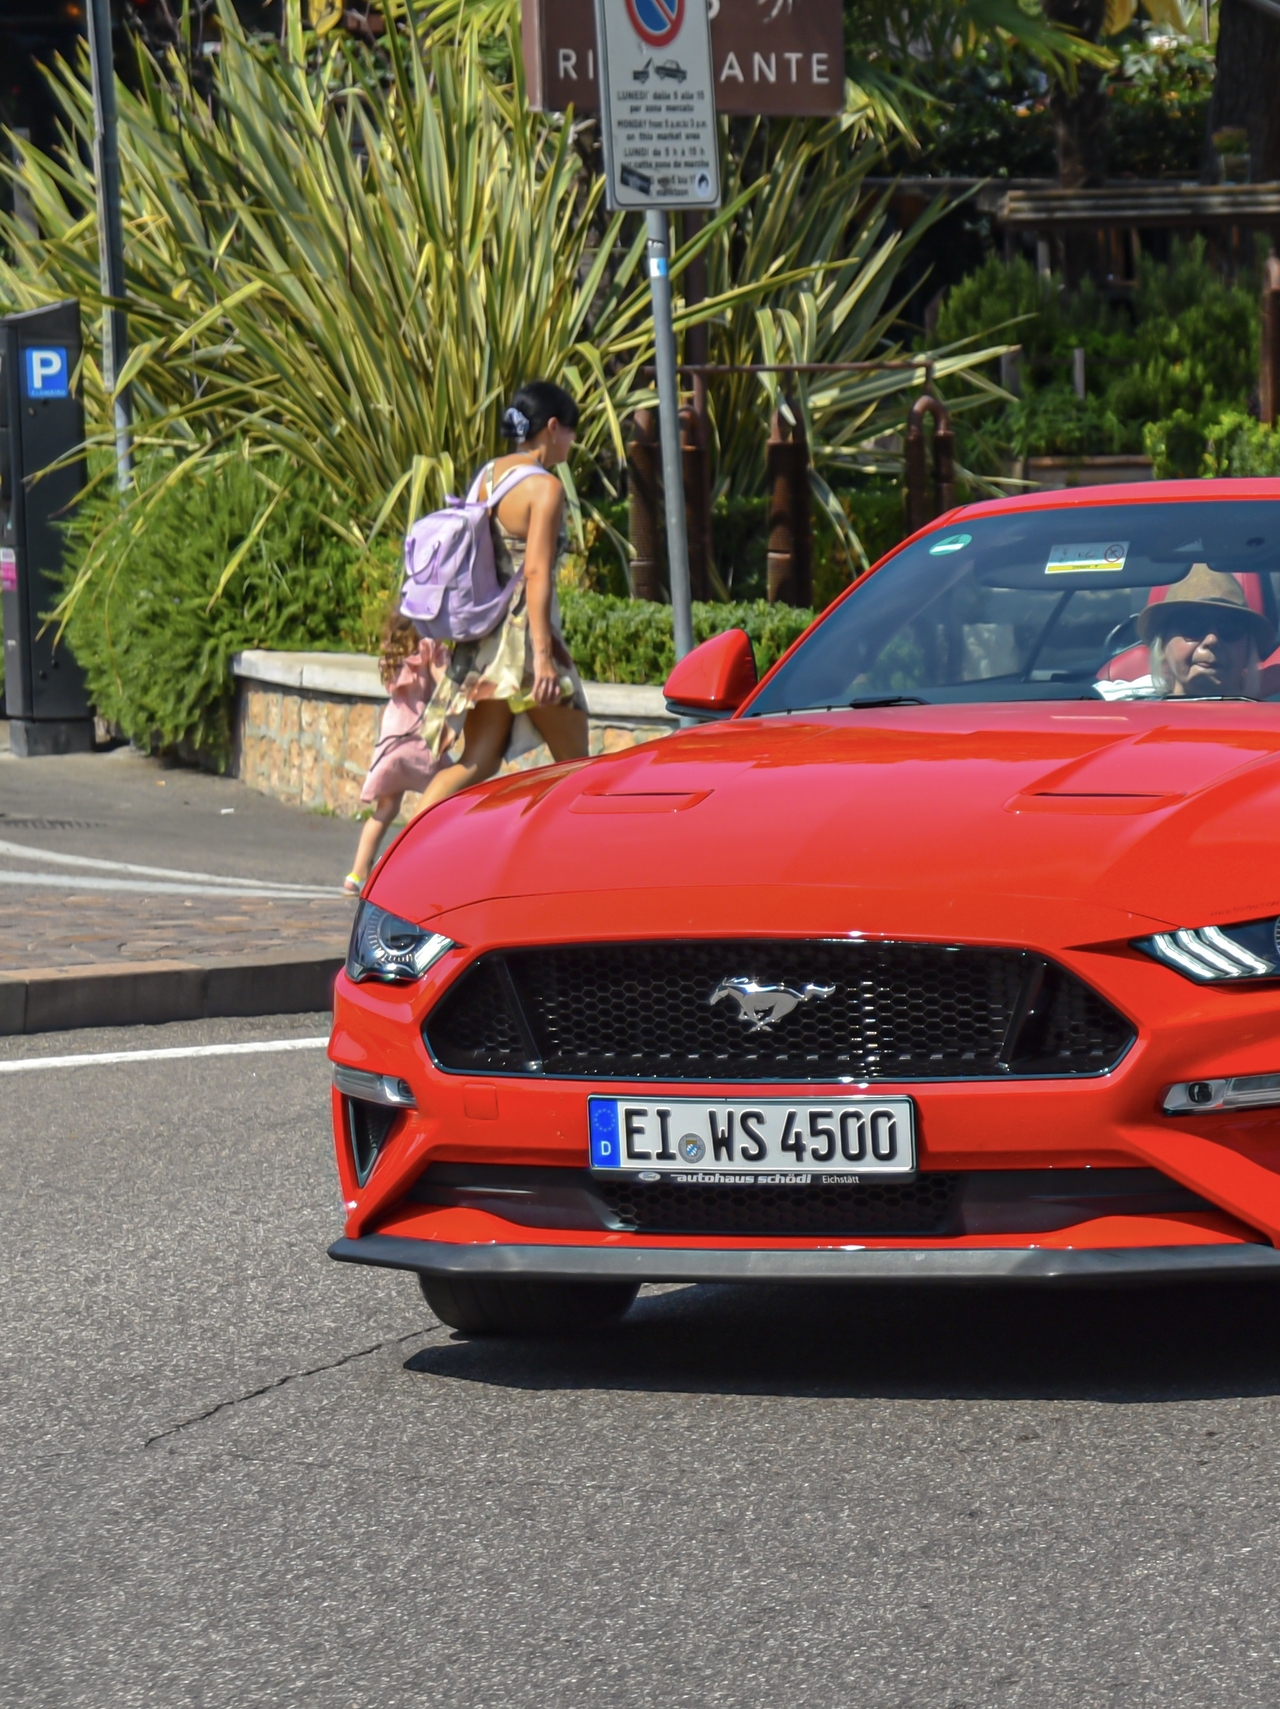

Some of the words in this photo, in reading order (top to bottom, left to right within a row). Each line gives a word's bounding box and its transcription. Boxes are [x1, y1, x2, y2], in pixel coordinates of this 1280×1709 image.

[558, 49, 831, 84] RIANTE
[32, 350, 62, 389] P
[601, 1141, 611, 1155] D
[624, 1106, 677, 1161] EI
[708, 1108, 768, 1163] WS
[780, 1108, 897, 1163] 4500
[671, 1172, 754, 1183] autohaus
[757, 1173, 812, 1184] schödl
[822, 1174, 859, 1184] Eichstätt
